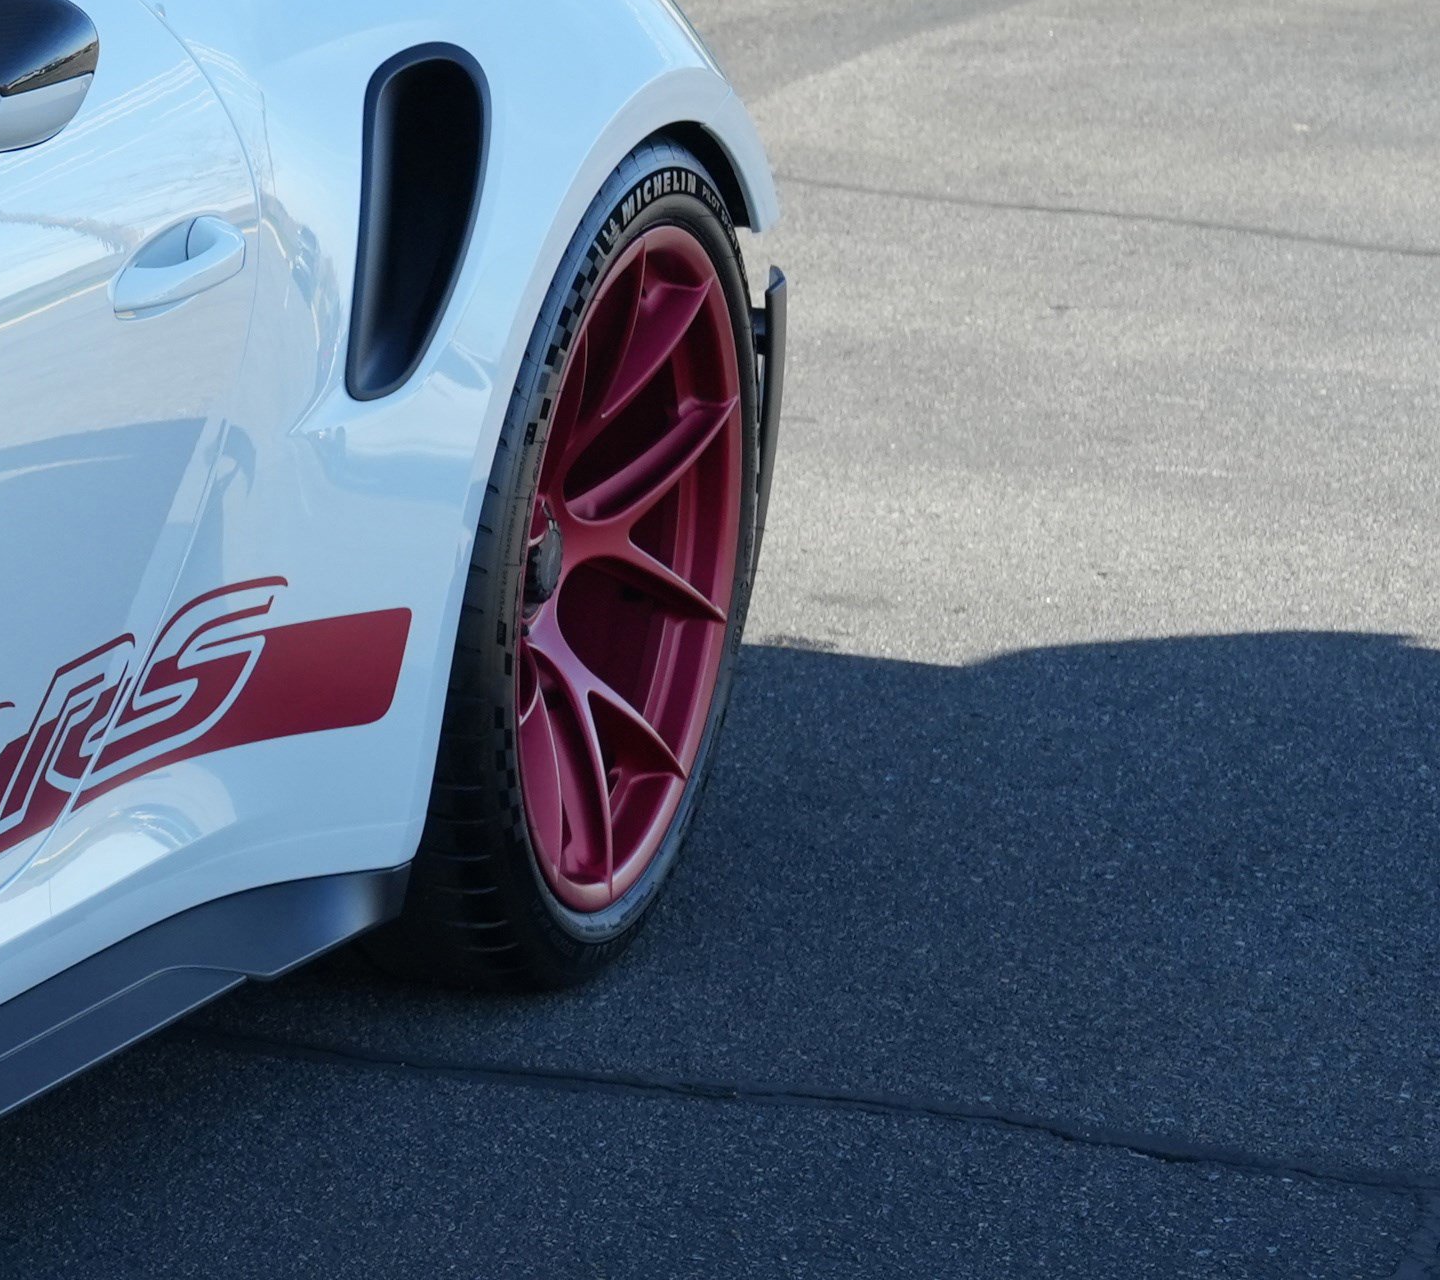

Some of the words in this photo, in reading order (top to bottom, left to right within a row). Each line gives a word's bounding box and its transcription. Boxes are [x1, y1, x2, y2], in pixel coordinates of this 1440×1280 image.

[621, 171, 697, 227] MICHELIN
[702, 185, 721, 212] PILOT
[721, 210, 739, 250] SPORT
